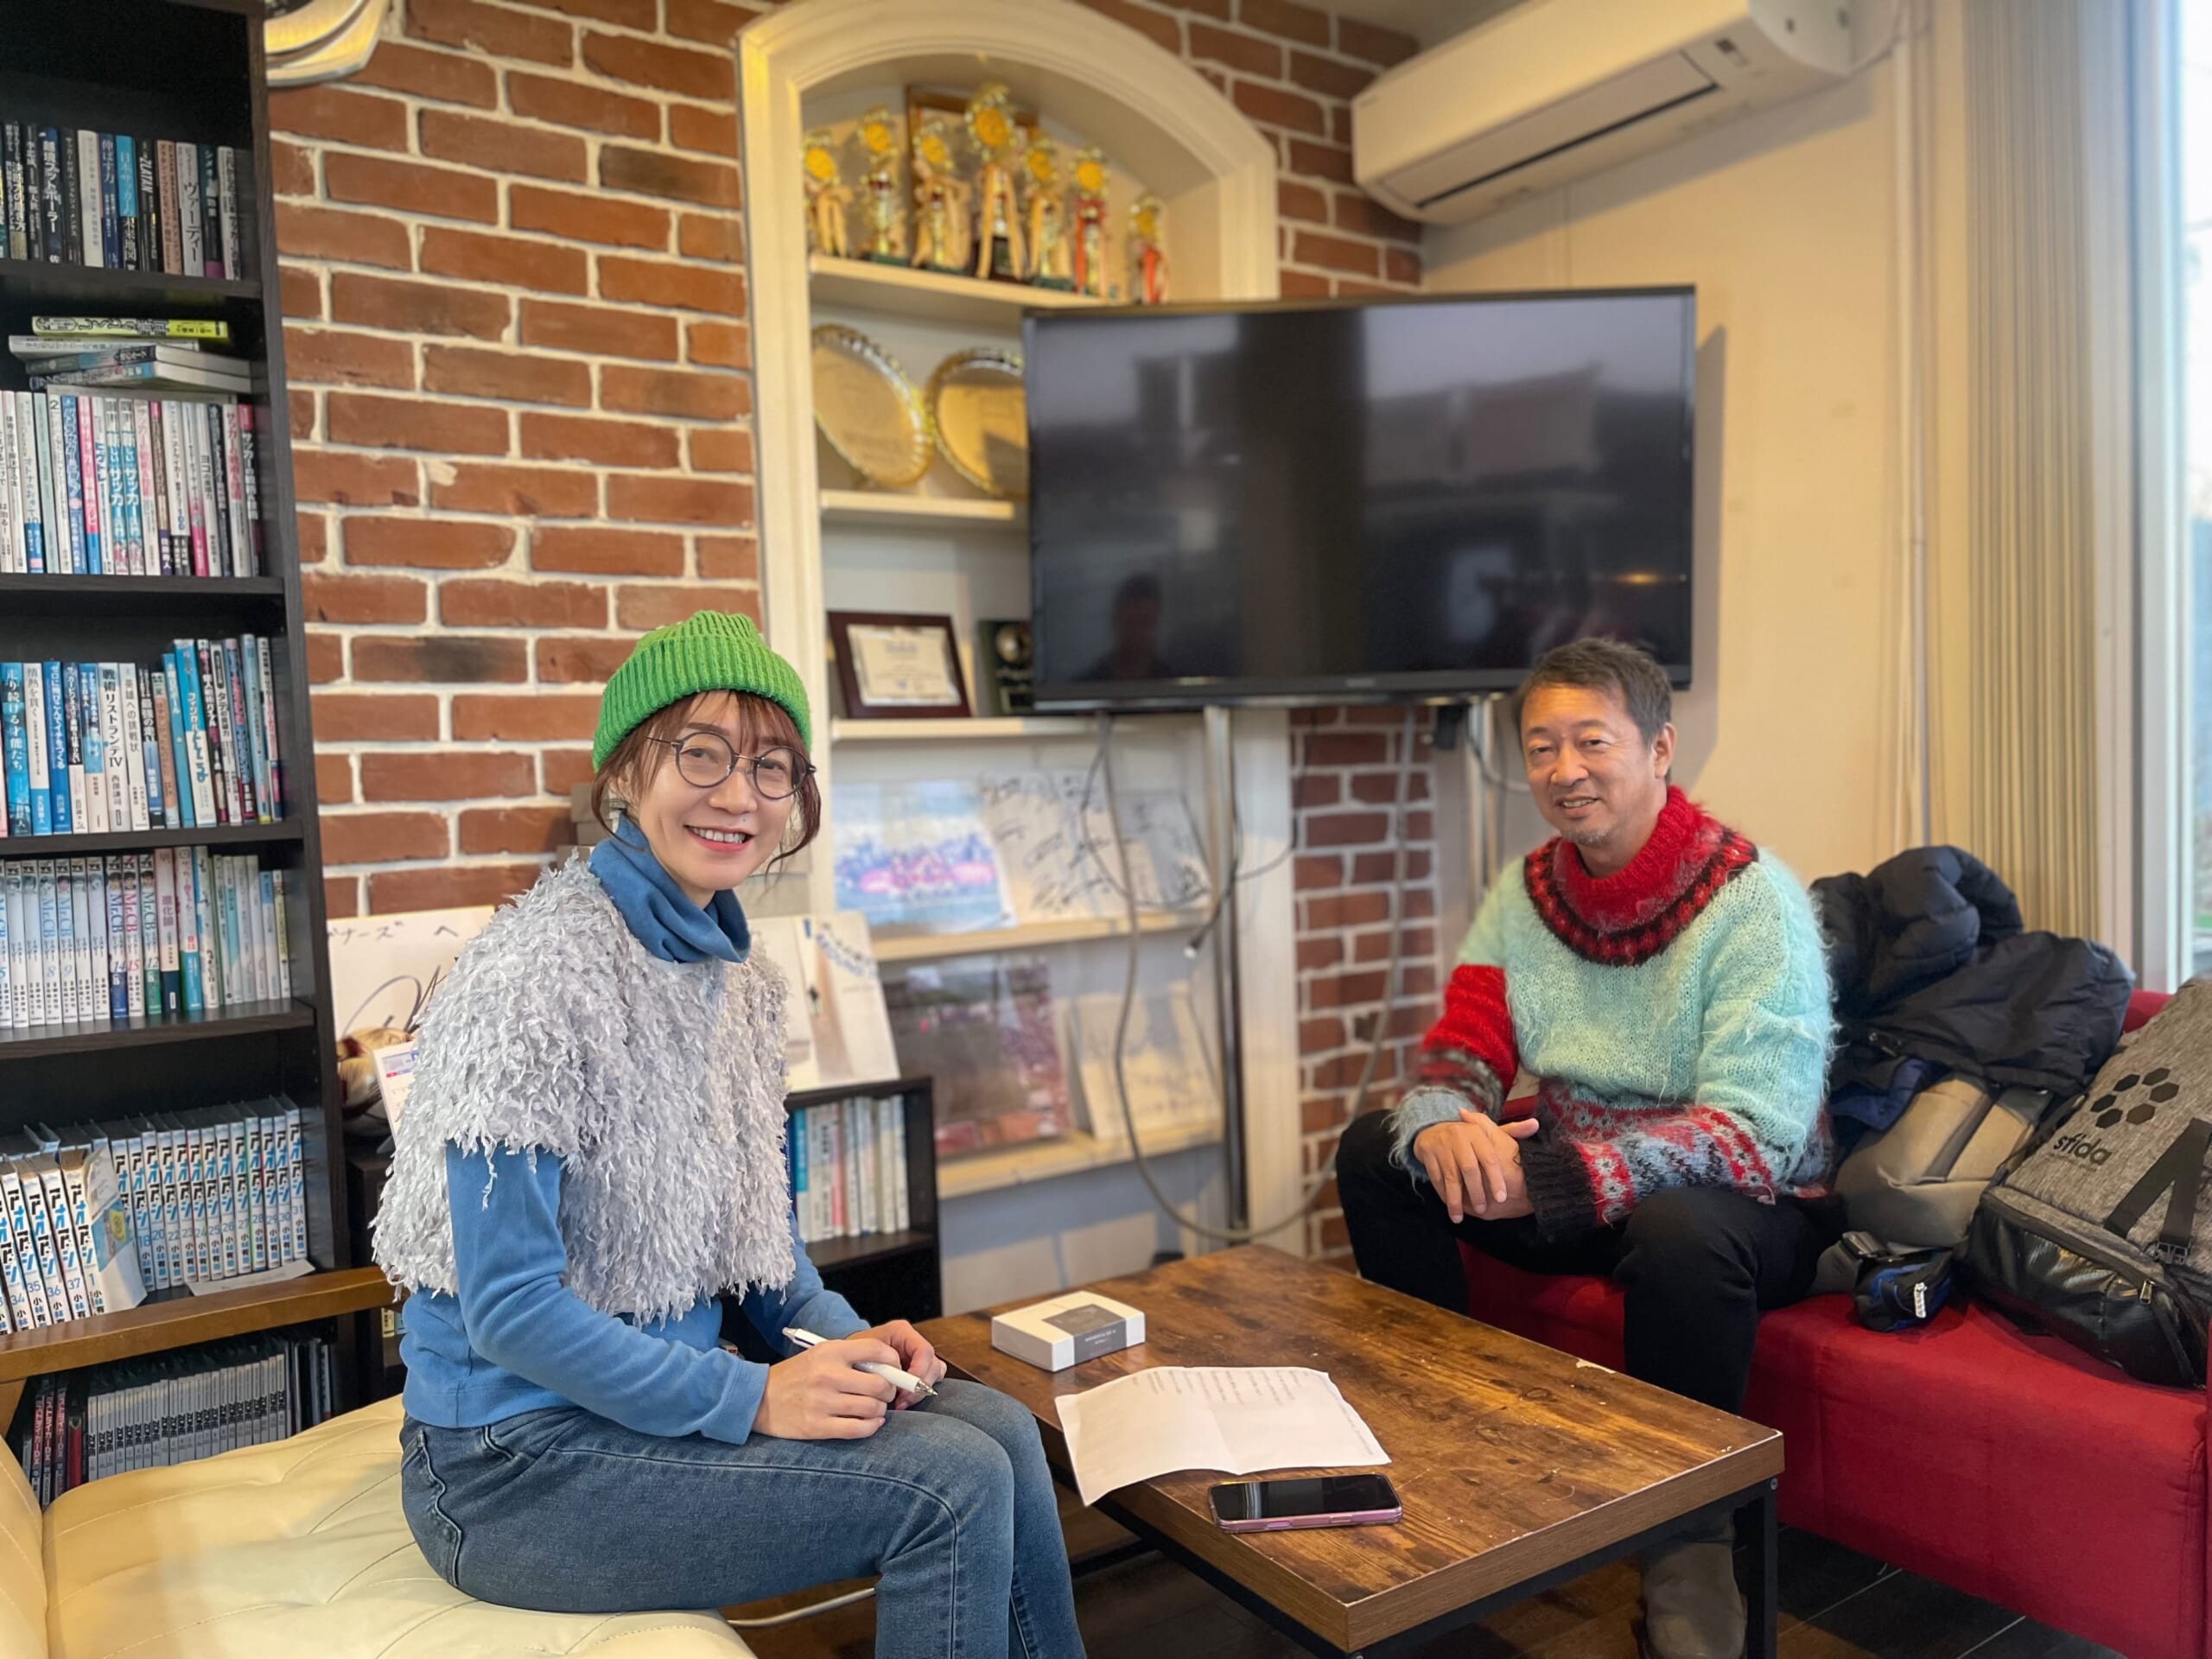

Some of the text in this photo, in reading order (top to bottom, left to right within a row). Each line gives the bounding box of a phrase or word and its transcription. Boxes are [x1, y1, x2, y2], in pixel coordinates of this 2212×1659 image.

[139, 156, 153, 194] ZLATAN
[50, 400, 59, 410] 2
[27, 667, 40, 719] 情熱を貫く
[6, 668, 23, 772] 走り続ける才能たち
[41, 898, 55, 938] Mr.CB
[59, 898, 72, 938] Mr.CB
[111, 893, 124, 933] Mr.CB
[124, 893, 138, 932] Mr.CB
[143, 892, 156, 931] Mr.CB
[2053, 1133, 2113, 1166] sfida
